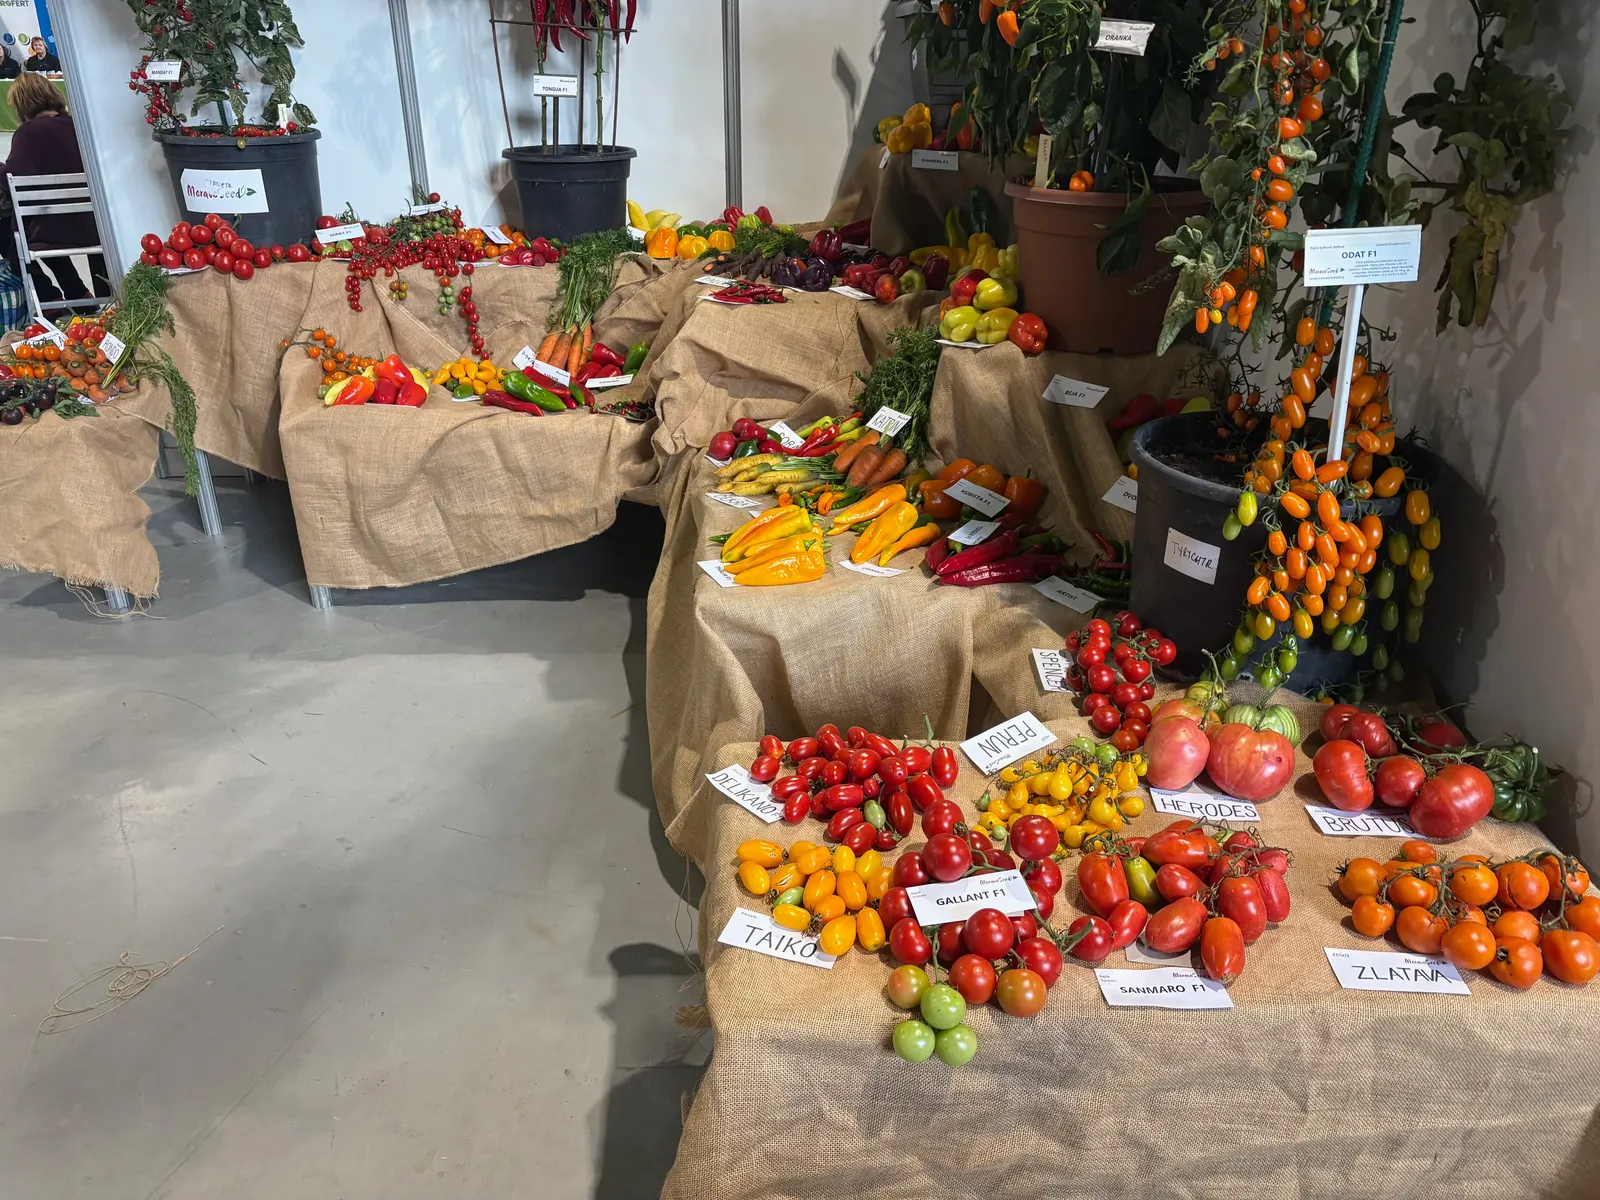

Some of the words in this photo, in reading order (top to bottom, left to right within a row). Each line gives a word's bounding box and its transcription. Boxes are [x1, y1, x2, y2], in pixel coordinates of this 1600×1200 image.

[1341, 250, 1366, 259] ODAT
[1367, 250, 1378, 258] F1
[1122, 491, 1138, 502] DVO
[1056, 589, 1079, 600] ARTIST
[977, 720, 1037, 758] PERUN
[711, 772, 777, 815] DELIKANO
[1160, 797, 1258, 818] HERODES
[1322, 815, 1416, 835] BRUTUS
[935, 890, 990, 907] GALLANT
[992, 887, 1007, 898] F1
[744, 924, 818, 958] TAIKO
[1351, 965, 1453, 983] ZLATAVA
[1119, 983, 1186, 995] SANMARO
[1192, 984, 1207, 993] F1
